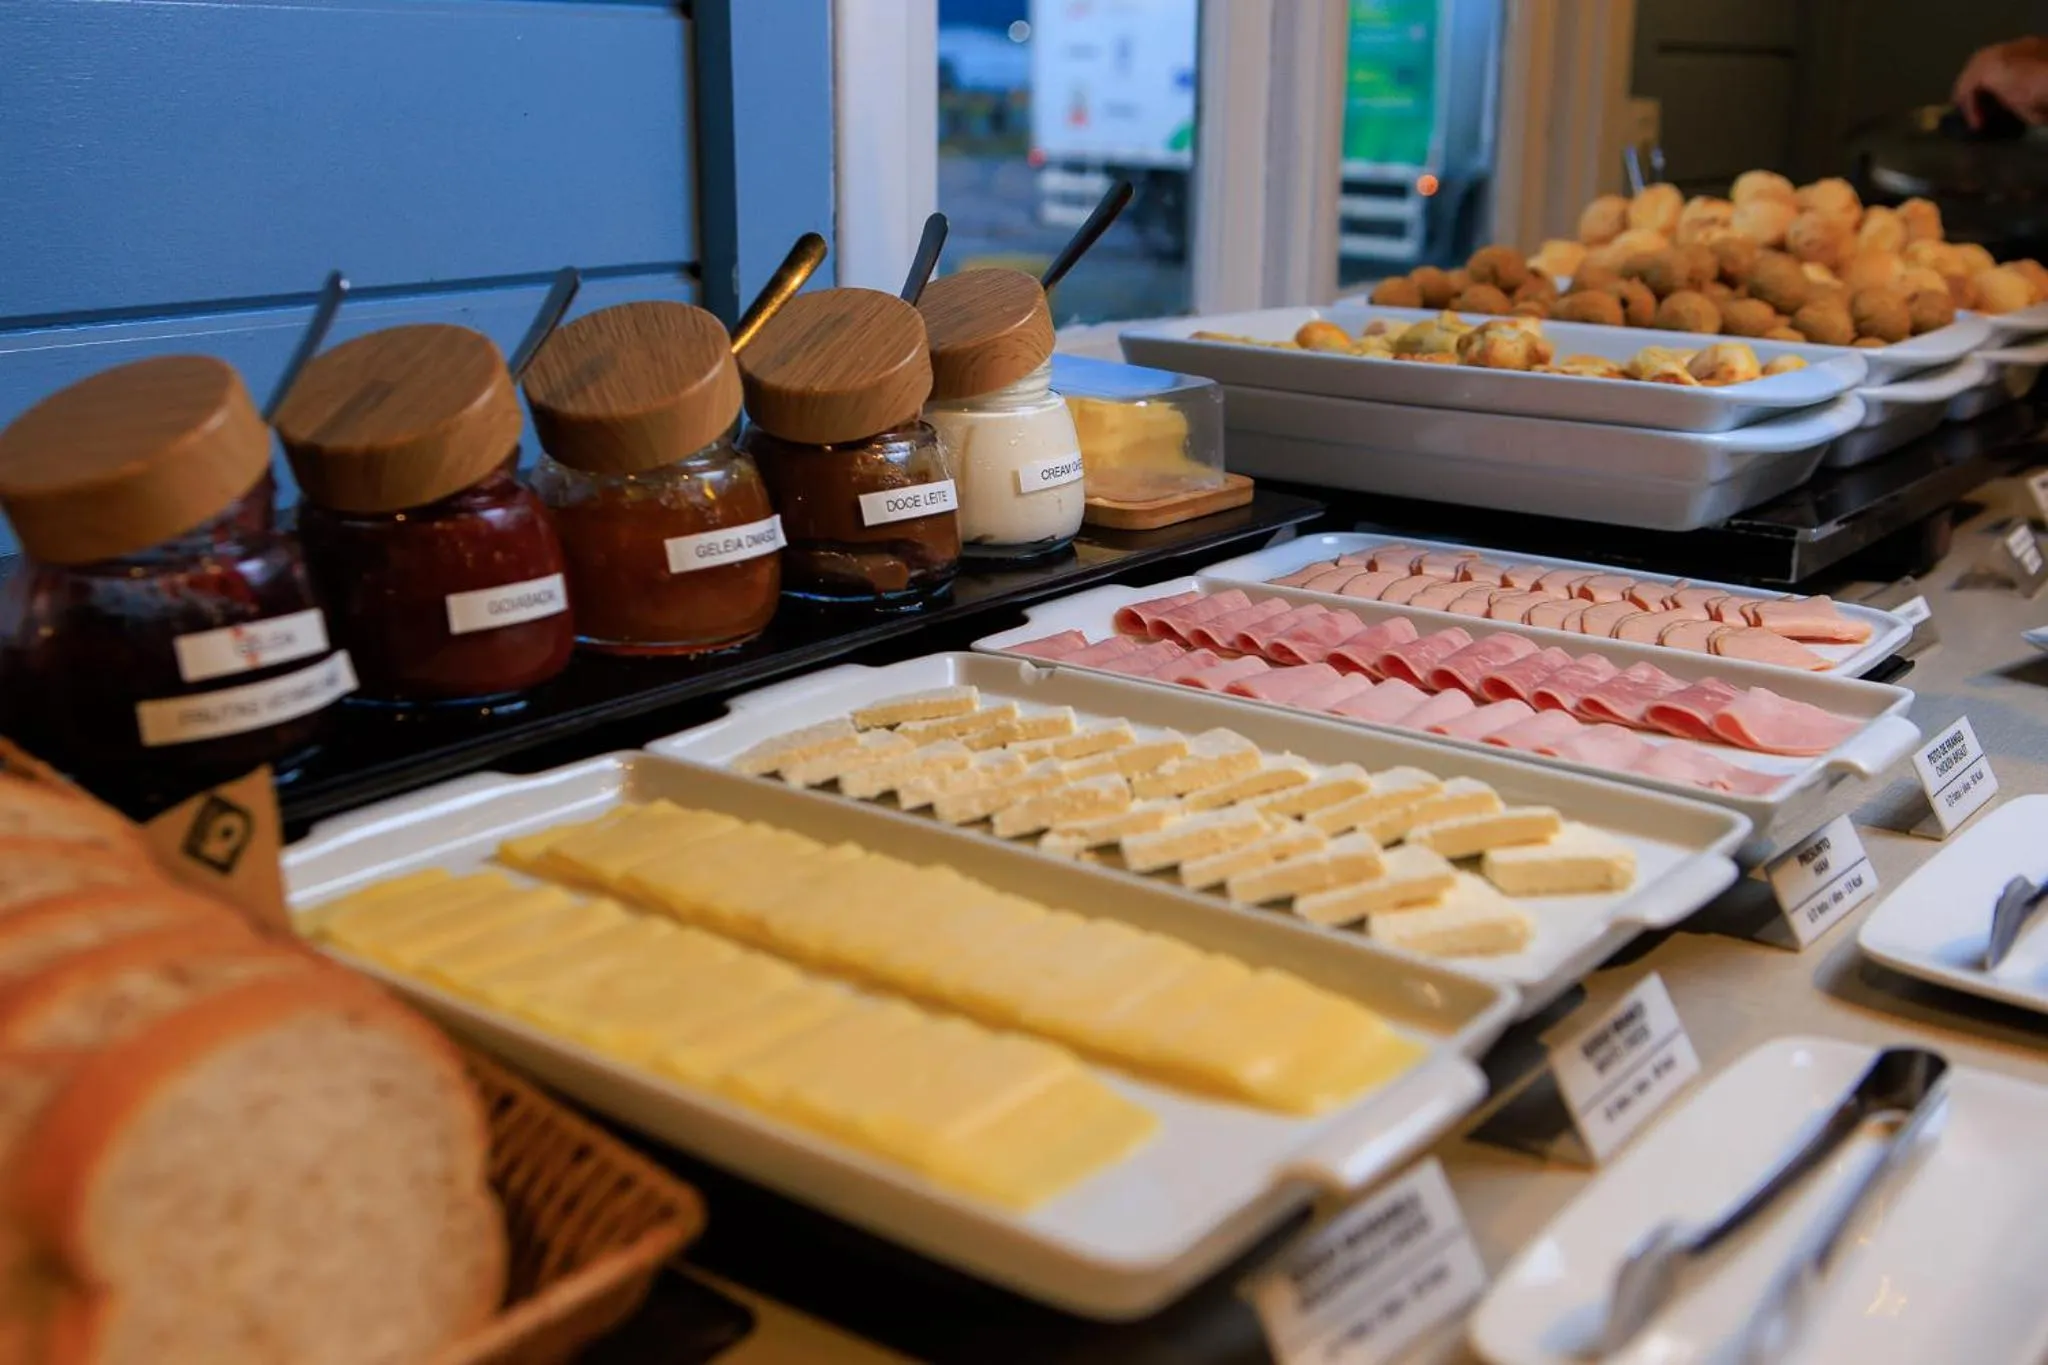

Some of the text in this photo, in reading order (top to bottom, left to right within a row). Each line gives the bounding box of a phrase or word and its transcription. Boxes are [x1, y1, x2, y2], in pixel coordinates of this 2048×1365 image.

[1041, 464, 1071, 480] CREAM
[886, 490, 948, 512] DOCE LEITE
[695, 537, 744, 558] GELEIA
